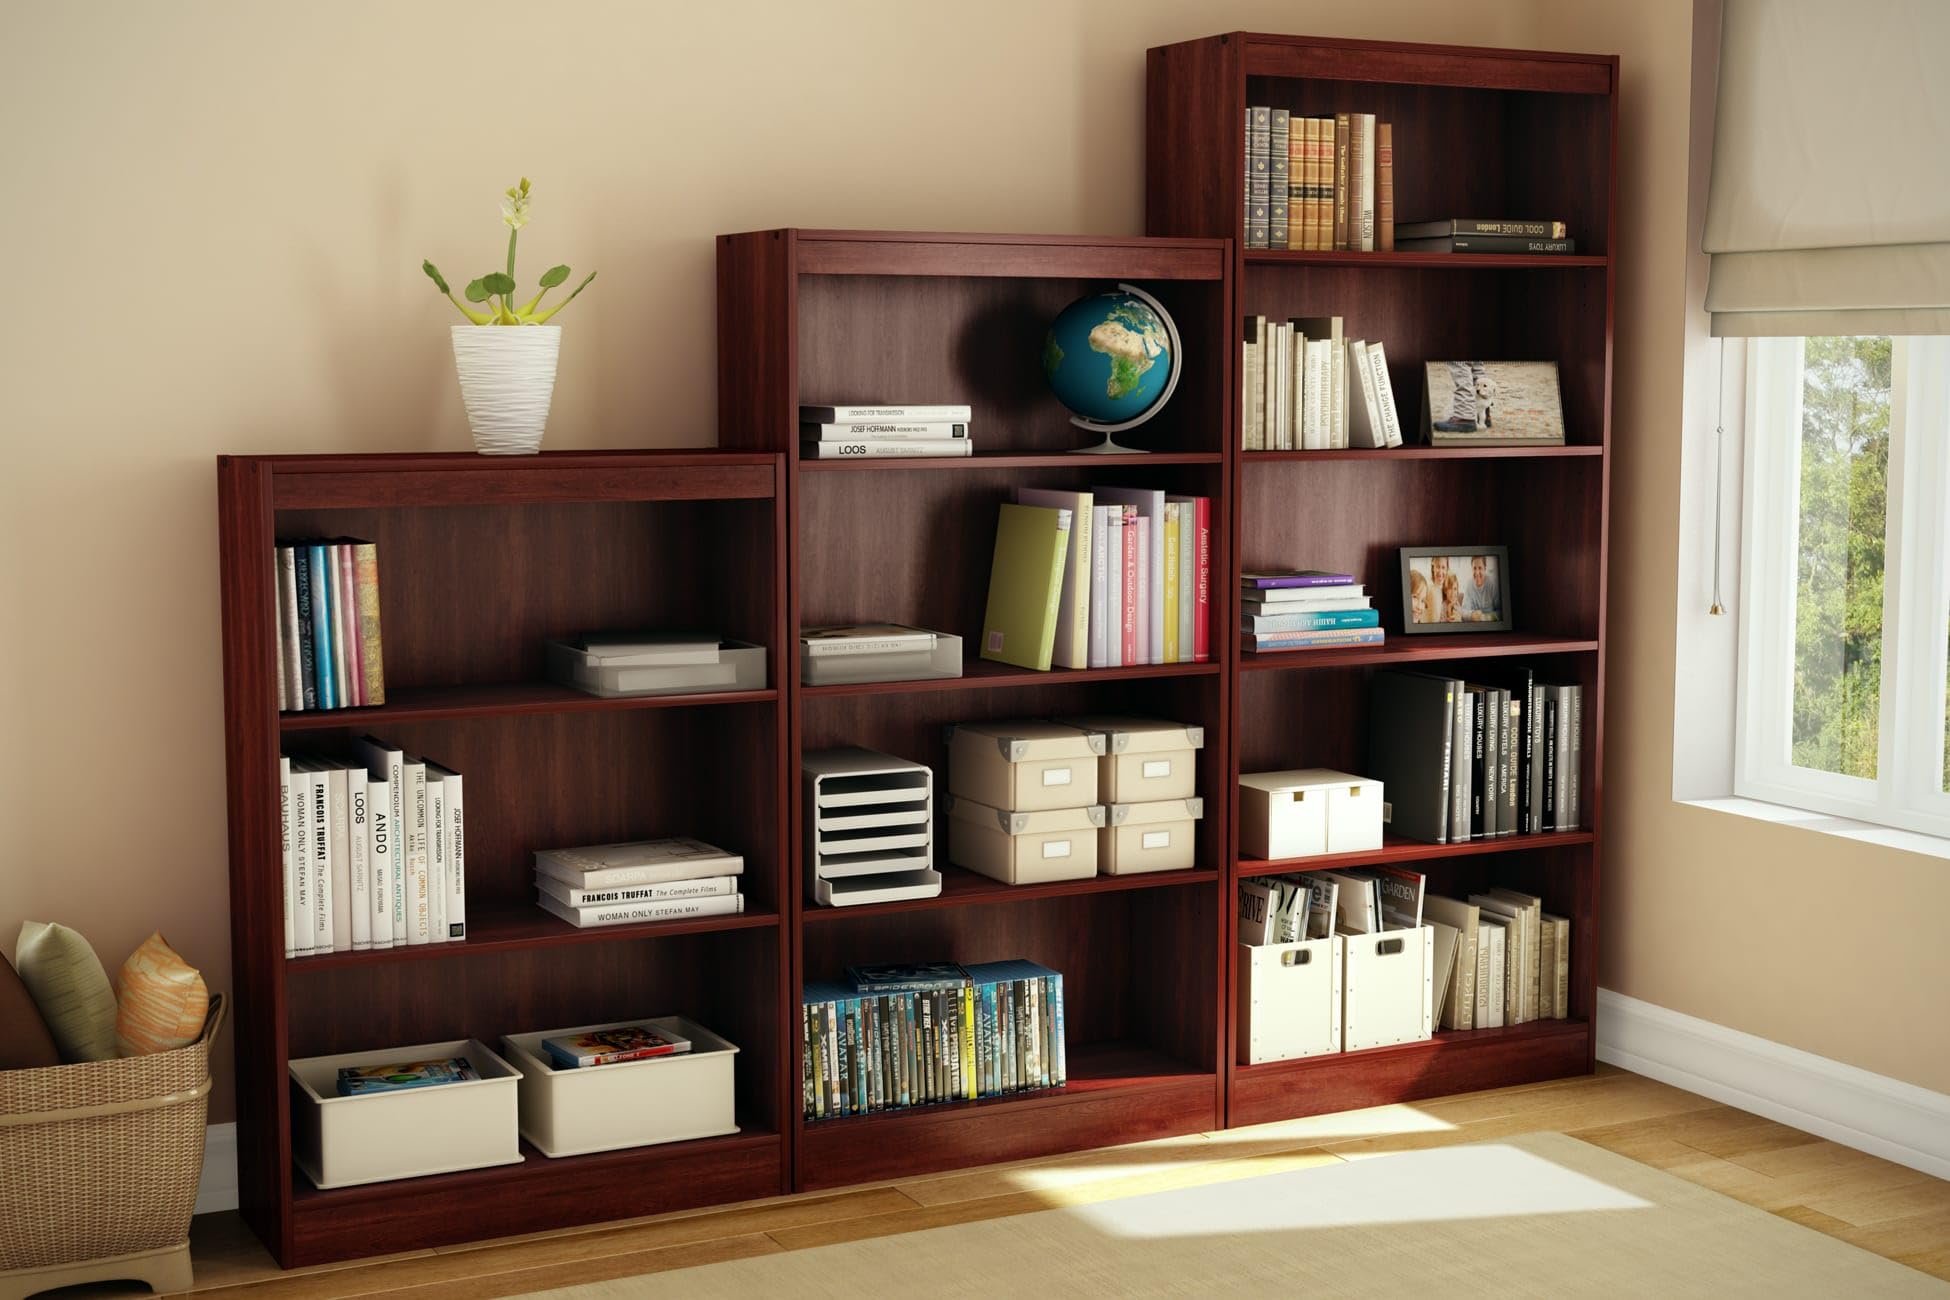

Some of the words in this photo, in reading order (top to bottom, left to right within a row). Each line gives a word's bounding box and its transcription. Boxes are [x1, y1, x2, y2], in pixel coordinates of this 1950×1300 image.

[1476, 223, 1501, 233] London
[1502, 224, 1524, 233] GUIDE
[1525, 225, 1544, 234] COOL
[1528, 242, 1544, 251] TOYS
[1373, 354, 1388, 391] FUNCTION
[1380, 394, 1393, 423] CHANGE
[1387, 425, 1397, 439] THE
[839, 445, 867, 455] LOOS
[1127, 530, 1135, 559] Garden
[1200, 527, 1209, 566] Aestetic
[1126, 570, 1135, 603] Outdoor
[1199, 567, 1209, 604] Surgery
[1125, 606, 1134, 633] Design
[1476, 703, 1484, 729] LUXURY
[1489, 702, 1497, 728] LUXURY
[1501, 701, 1509, 728] LUXURY
[1534, 697, 1542, 724] LUXURY
[1463, 731, 1471, 760] HOUSES
[1510, 727, 1518, 750] COOL
[416, 771, 424, 785] THE
[1488, 766, 1496, 781] NEW
[1510, 751, 1518, 776] GUIDE
[392, 764, 400, 817] COMPENDIUM
[1487, 782, 1495, 801] YORK
[1500, 764, 1508, 794] AMERICA
[1509, 778, 1518, 806] London
[280, 785, 290, 852] BAUHAUS
[296, 793, 305, 828] WOMAN
[315, 784, 325, 824] FRANCOIS
[354, 792, 365, 824] LOOS
[416, 789, 425, 828] UNCOMMON
[453, 808, 461, 825] JOSEF
[297, 829, 306, 854] ONLY
[316, 827, 327, 861] TRUFFAT
[375, 813, 387, 854] ANDO
[417, 832, 425, 852] LIFE
[454, 825, 462, 859] HOFFMANN
[355, 835, 363, 862] AUGUST
[393, 819, 401, 881] ARCHITECTURAL
[417, 855, 426, 865] OF
[298, 856, 306, 887] STEFAN
[317, 864, 326, 877] The
[356, 863, 364, 892] SARNITZ
[418, 870, 426, 899] COMMON
[317, 879, 326, 911] Complete
[394, 883, 402, 922] ANTIQUES
[582, 892, 619, 903] FRANCOIS
[621, 889, 653, 900] TRUFFAT
[655, 889, 668, 897] The
[669, 886, 698, 896] Complete
[699, 884, 717, 893] Films
[1382, 877, 1416, 902] GARDEN
[318, 913, 327, 932] Films
[418, 903, 427, 937] OBJECTS
[597, 912, 630, 921] WOMAN
[631, 909, 653, 919] ONLY
[655, 907, 683, 917] STEFAN
[684, 905, 699, 914] MAY
[983, 1013, 992, 1062] AVATAR
[820, 1033, 829, 1082] X-MEN
[837, 1030, 848, 1081] AVATAR
[950, 1033, 960, 1094] PREDATOR
